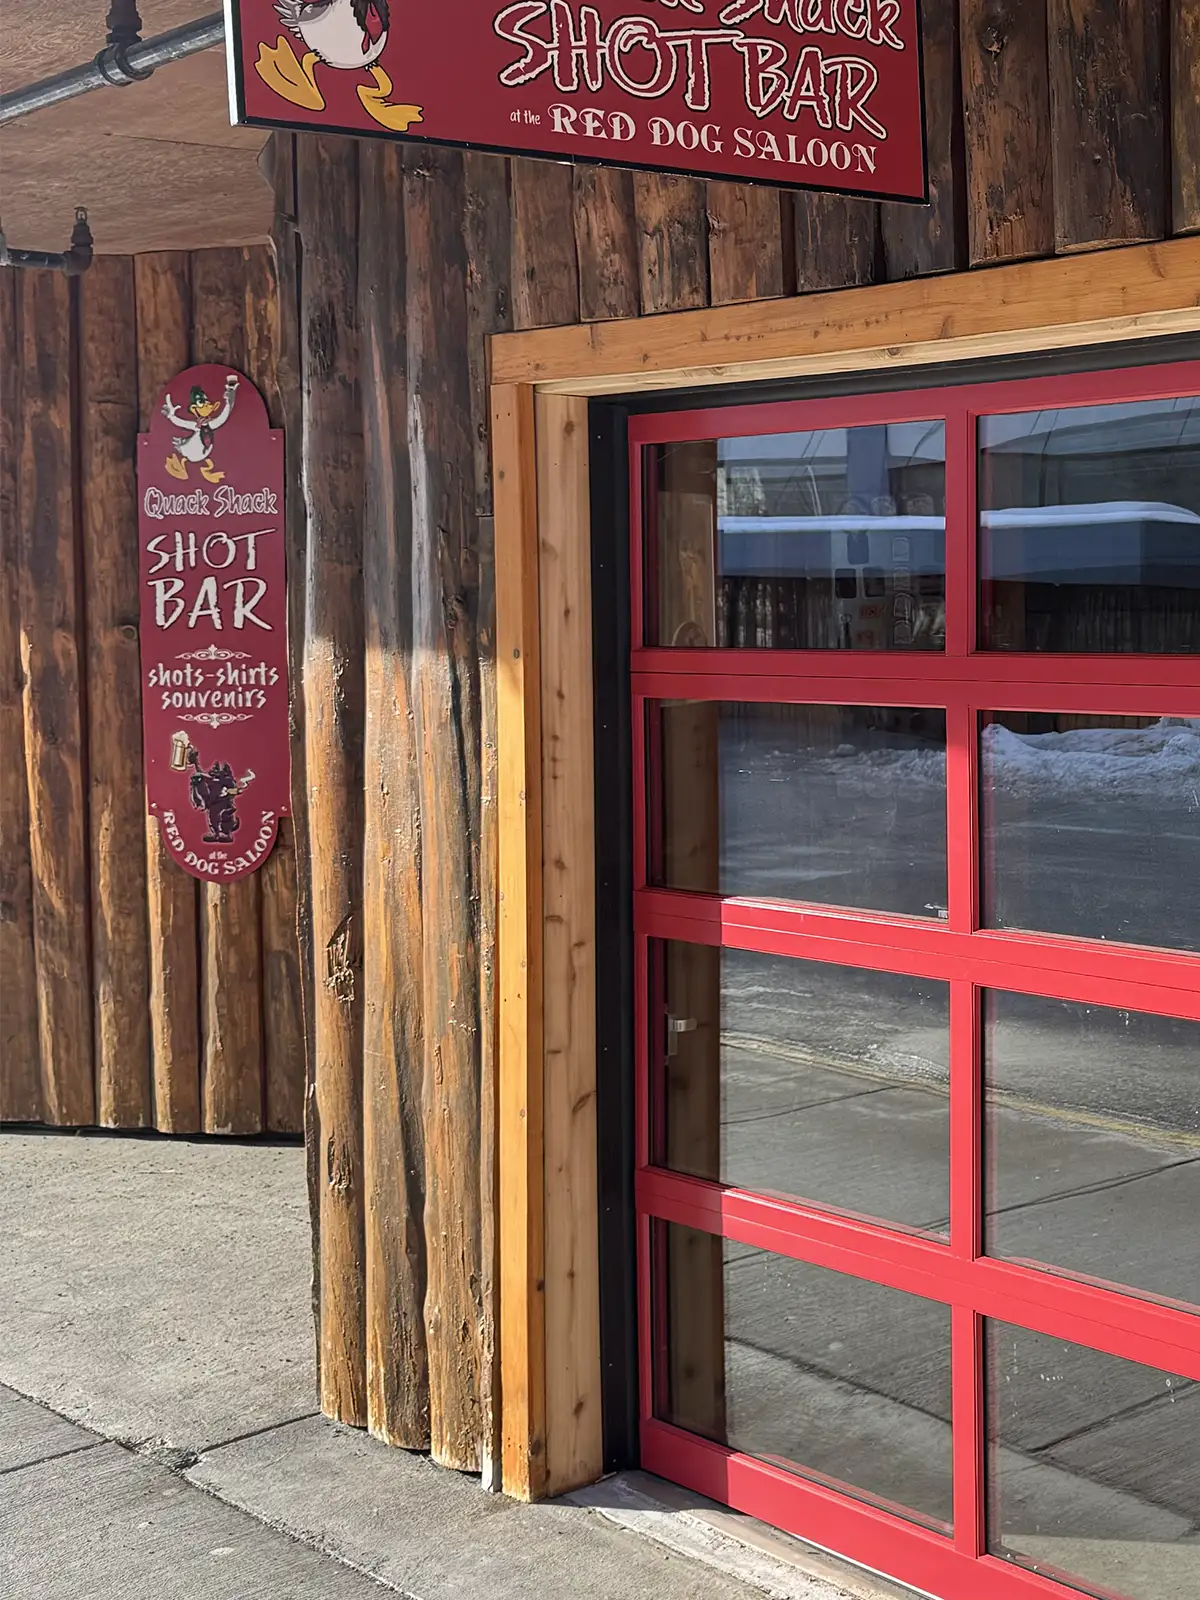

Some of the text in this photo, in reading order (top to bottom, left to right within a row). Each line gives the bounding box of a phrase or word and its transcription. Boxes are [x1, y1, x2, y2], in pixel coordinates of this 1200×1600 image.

[494, 0, 887, 140] SHOT BAR
[509, 103, 878, 175] at the RED DOG SALOON
[143, 485, 278, 519] Quack Shack
[146, 528, 277, 574] SHOT
[147, 576, 274, 630] BAR
[148, 662, 279, 688] shots-shirts
[161, 687, 267, 710] souvenirs
[163, 809, 275, 875] RED DOG SALOON
